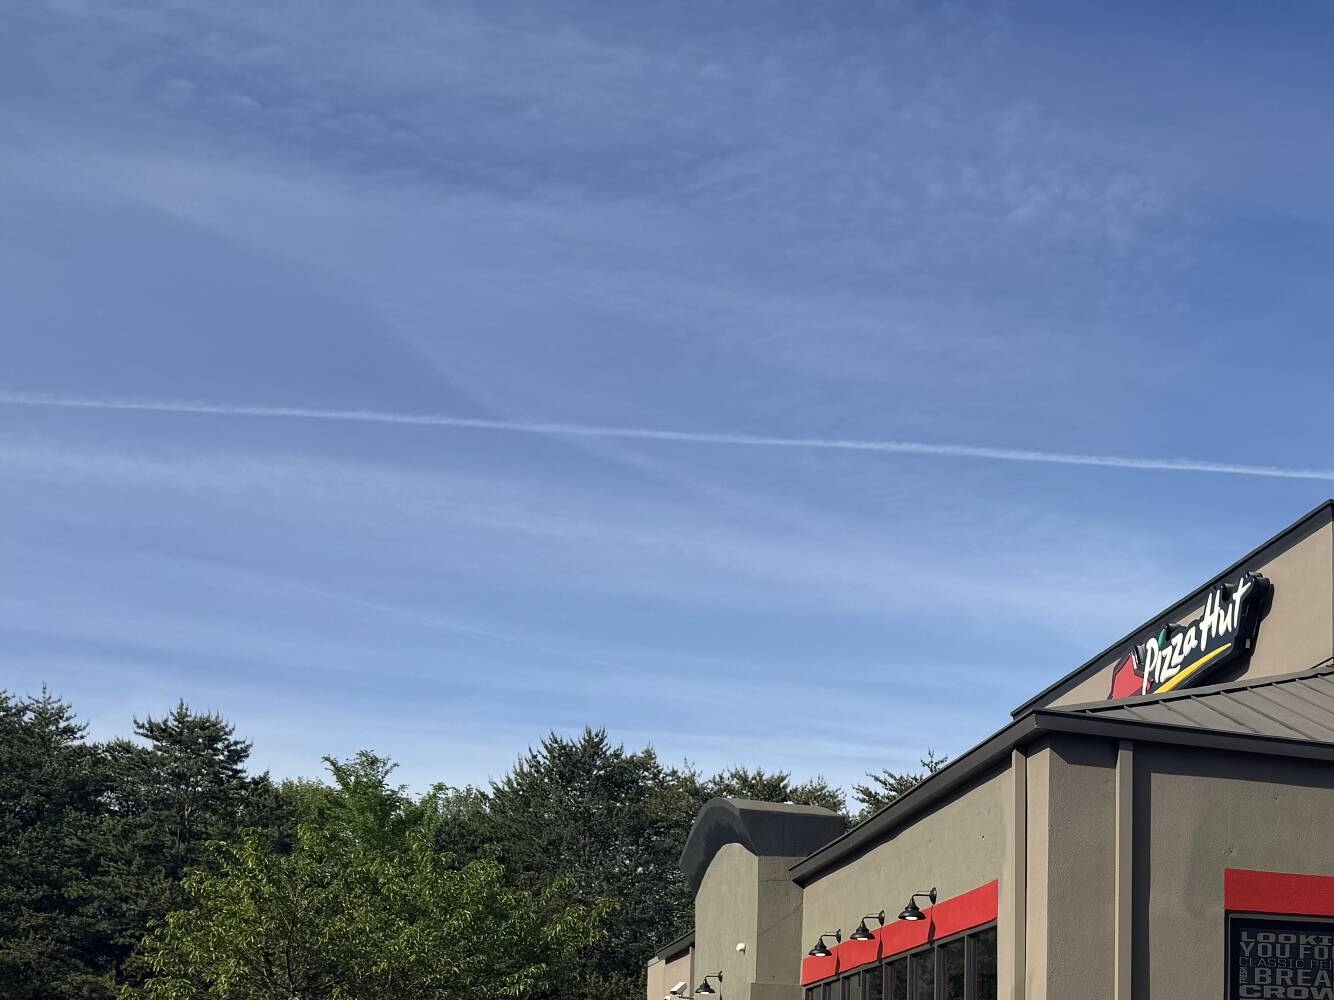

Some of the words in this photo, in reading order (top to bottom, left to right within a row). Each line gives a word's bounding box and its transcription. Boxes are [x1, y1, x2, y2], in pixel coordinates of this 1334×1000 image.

[1142, 626, 1198, 695] Pizza
[1200, 577, 1251, 651] Hut
[1240, 942, 1290, 959] YOU
[1239, 957, 1305, 968] CLASSIC
